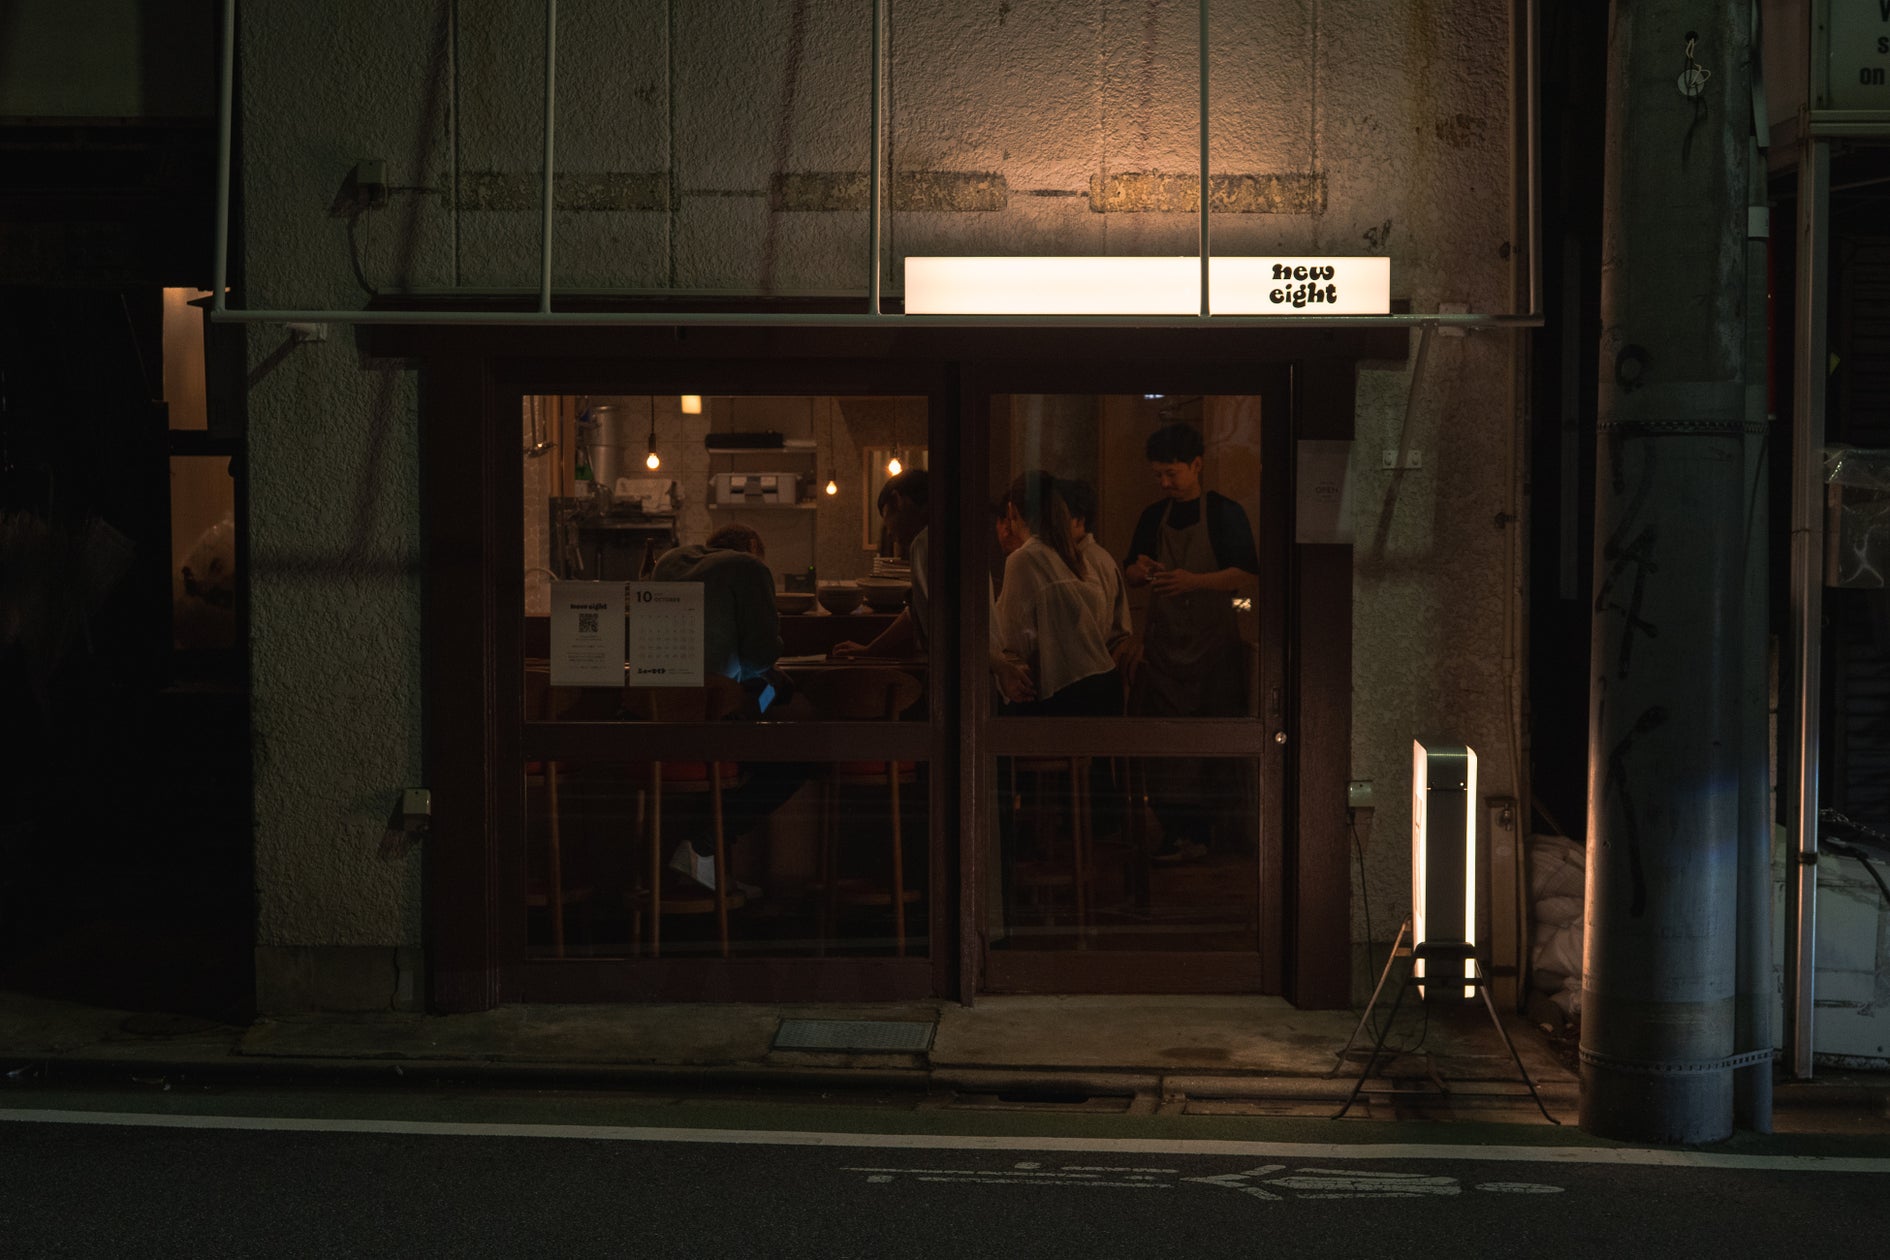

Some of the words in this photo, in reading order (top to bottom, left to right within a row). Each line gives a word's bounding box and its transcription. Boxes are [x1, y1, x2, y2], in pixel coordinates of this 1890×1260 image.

[1860, 67, 1885, 85] on
[1272, 263, 1335, 281] new
[1269, 282, 1337, 308] eight
[637, 591, 653, 603] 10
